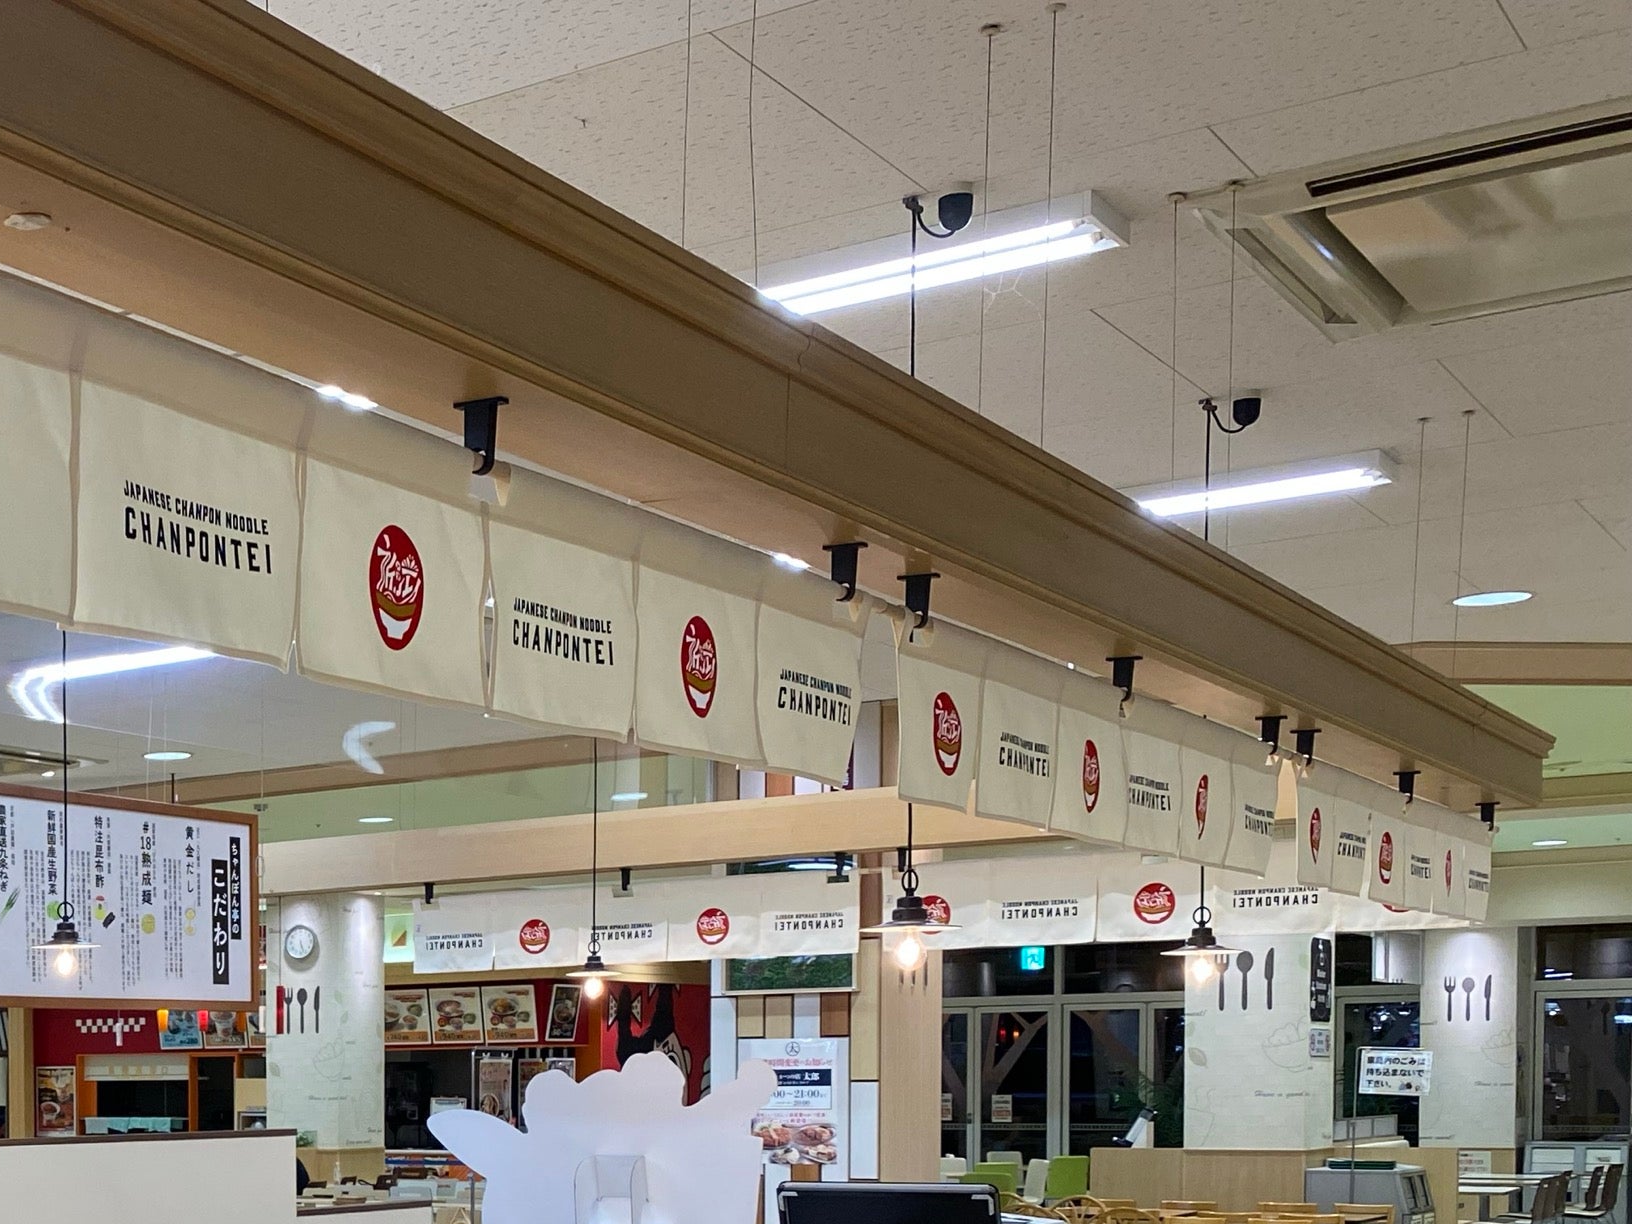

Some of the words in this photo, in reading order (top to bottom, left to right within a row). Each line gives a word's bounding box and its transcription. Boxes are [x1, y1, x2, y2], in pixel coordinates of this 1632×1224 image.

[124, 479, 172, 512] JAPANESE
[175, 497, 222, 526] CHANPON
[225, 511, 269, 536] NOODLE
[124, 506, 272, 574] CHANPONTEI
[513, 619, 614, 666] CHANPONTEI
[514, 597, 548, 620] JAPANESE
[550, 607, 578, 628] CHANPON
[579, 616, 612, 634] NOODLE
[779, 668, 809, 686] JAPANESE
[777, 686, 851, 726] CHANPONTEI
[46, 809, 58, 895] 新鮮国産生野菜
[94, 815, 105, 888] 特注昆布酢
[184, 826, 195, 893] 黄金だし
[230, 843, 240, 934] ちゃんぽん亭の
[213, 868, 228, 976] こだわり
[1366, 1068, 1425, 1077] 持ち込まないで
[1366, 1080, 1392, 1088] 下さい。
